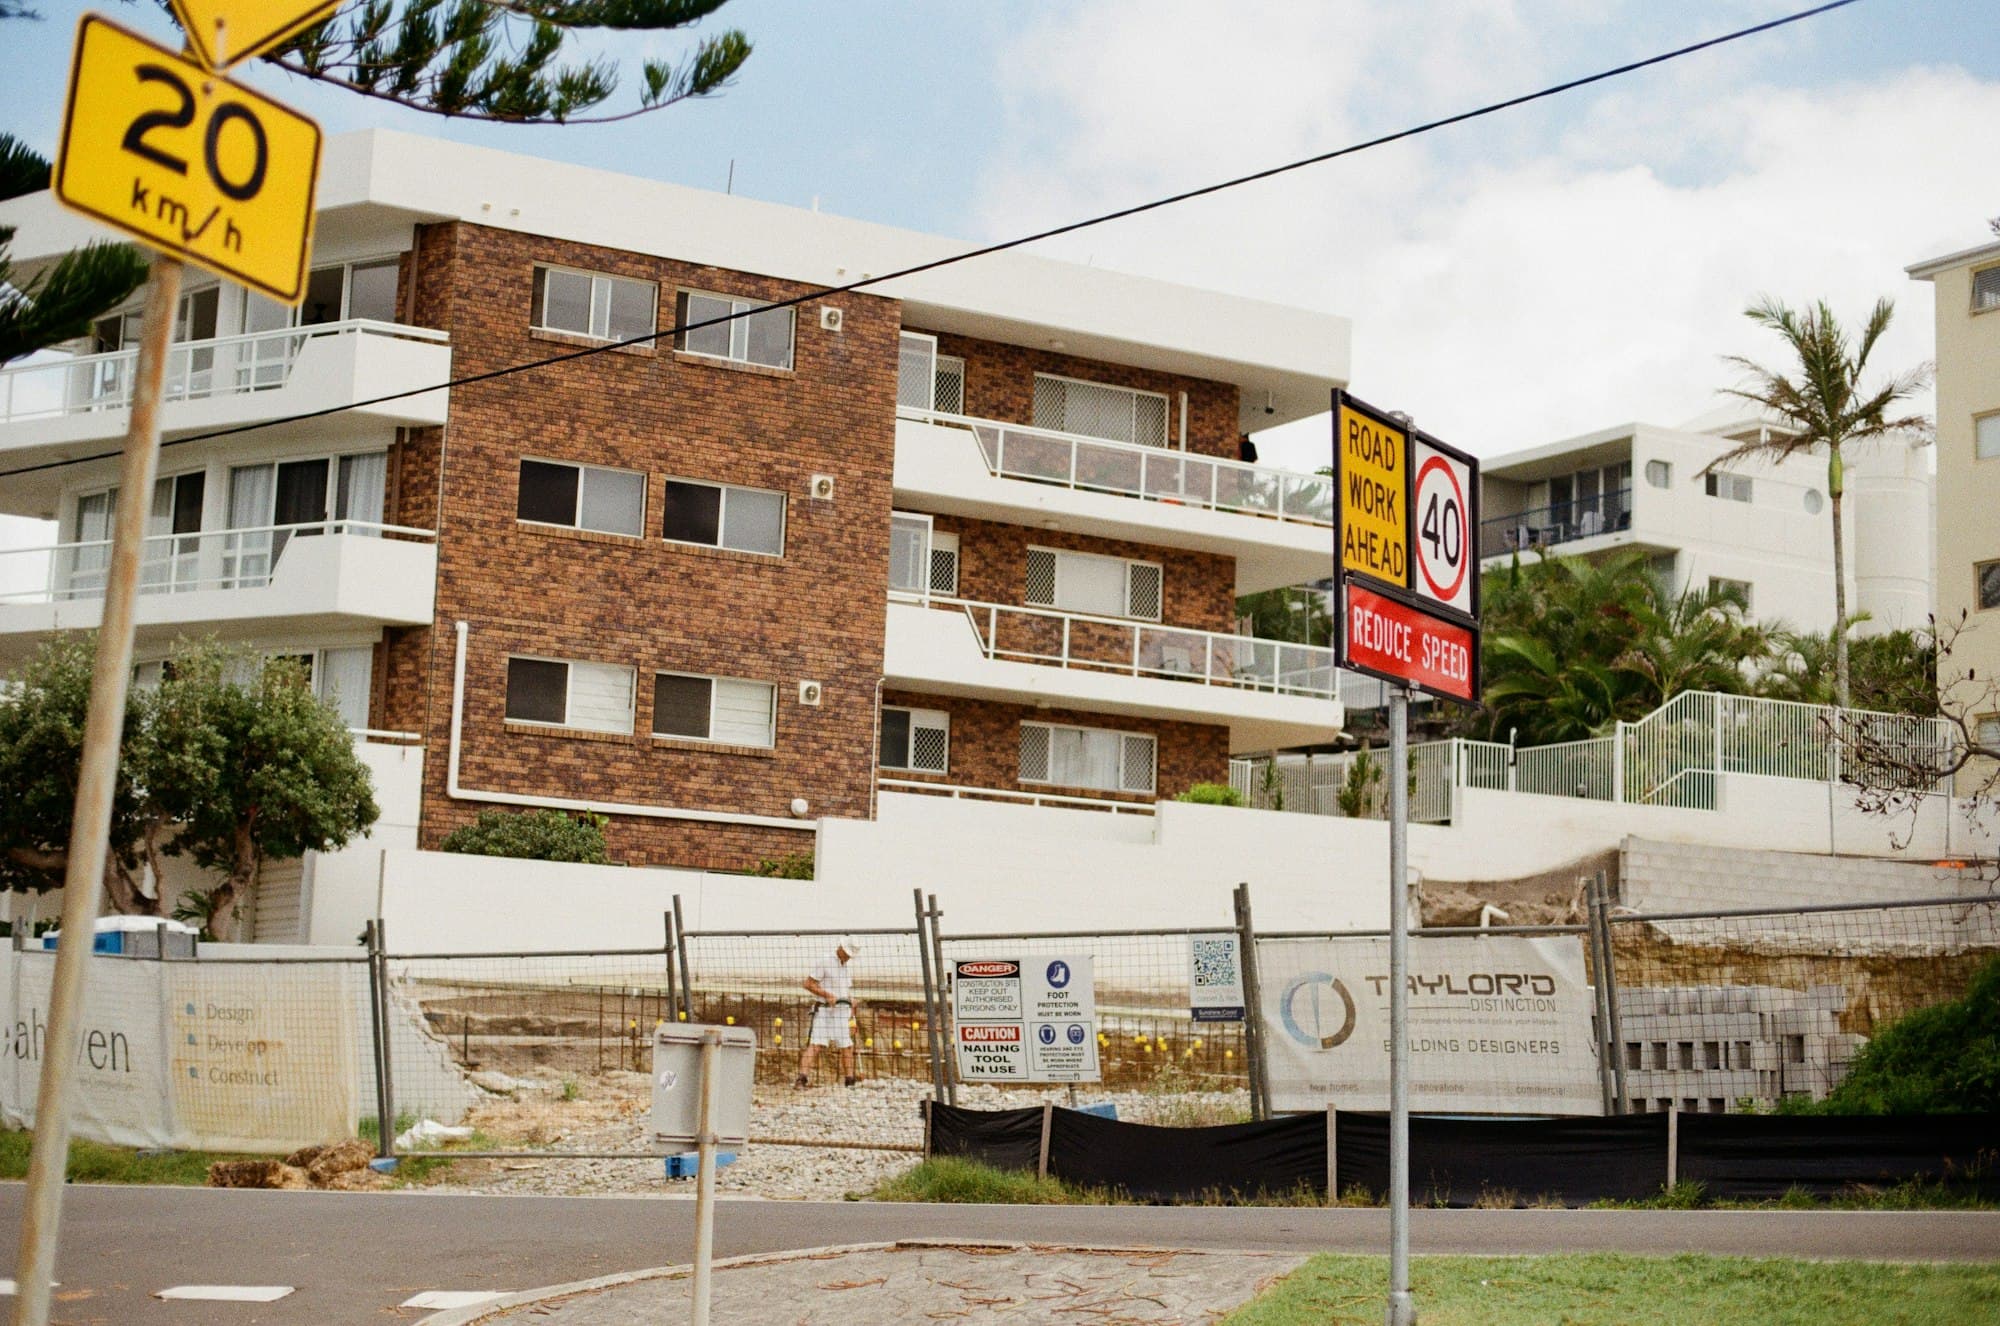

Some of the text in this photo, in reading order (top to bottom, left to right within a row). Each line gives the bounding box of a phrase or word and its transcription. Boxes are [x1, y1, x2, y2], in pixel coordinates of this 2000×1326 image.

[121, 63, 268, 201] 20
[130, 177, 243, 253] km/h
[1349, 419, 1396, 472] ROAD
[1349, 470, 1397, 526] WORK
[1422, 492, 1460, 567] 40
[1344, 523, 1404, 578] AHEAD
[1353, 606, 1468, 682] REDUCE SPEED
[963, 965, 1012, 973] DANGER
[959, 980, 1017, 988] CONSTRUCTION SITE
[965, 995, 1013, 1003] AUTHORISED
[1047, 991, 1070, 999] FOOT
[960, 1004, 996, 1012] PERSONS
[1470, 998, 1557, 1013] DISTINCTION
[207, 1003, 254, 1025] Design
[965, 1027, 1016, 1040] CAUTION
[208, 1034, 267, 1056] Develop
[963, 1044, 1020, 1053] NAILING
[1383, 1039, 1560, 1054] BLDING DESIGNERS
[973, 1055, 1011, 1063] TOOL
[209, 1067, 279, 1086] Construct
[971, 1065, 1017, 1073] IN USE
[1414, 1083, 1465, 1093] renovations
[1516, 1085, 1566, 1096] commercial
